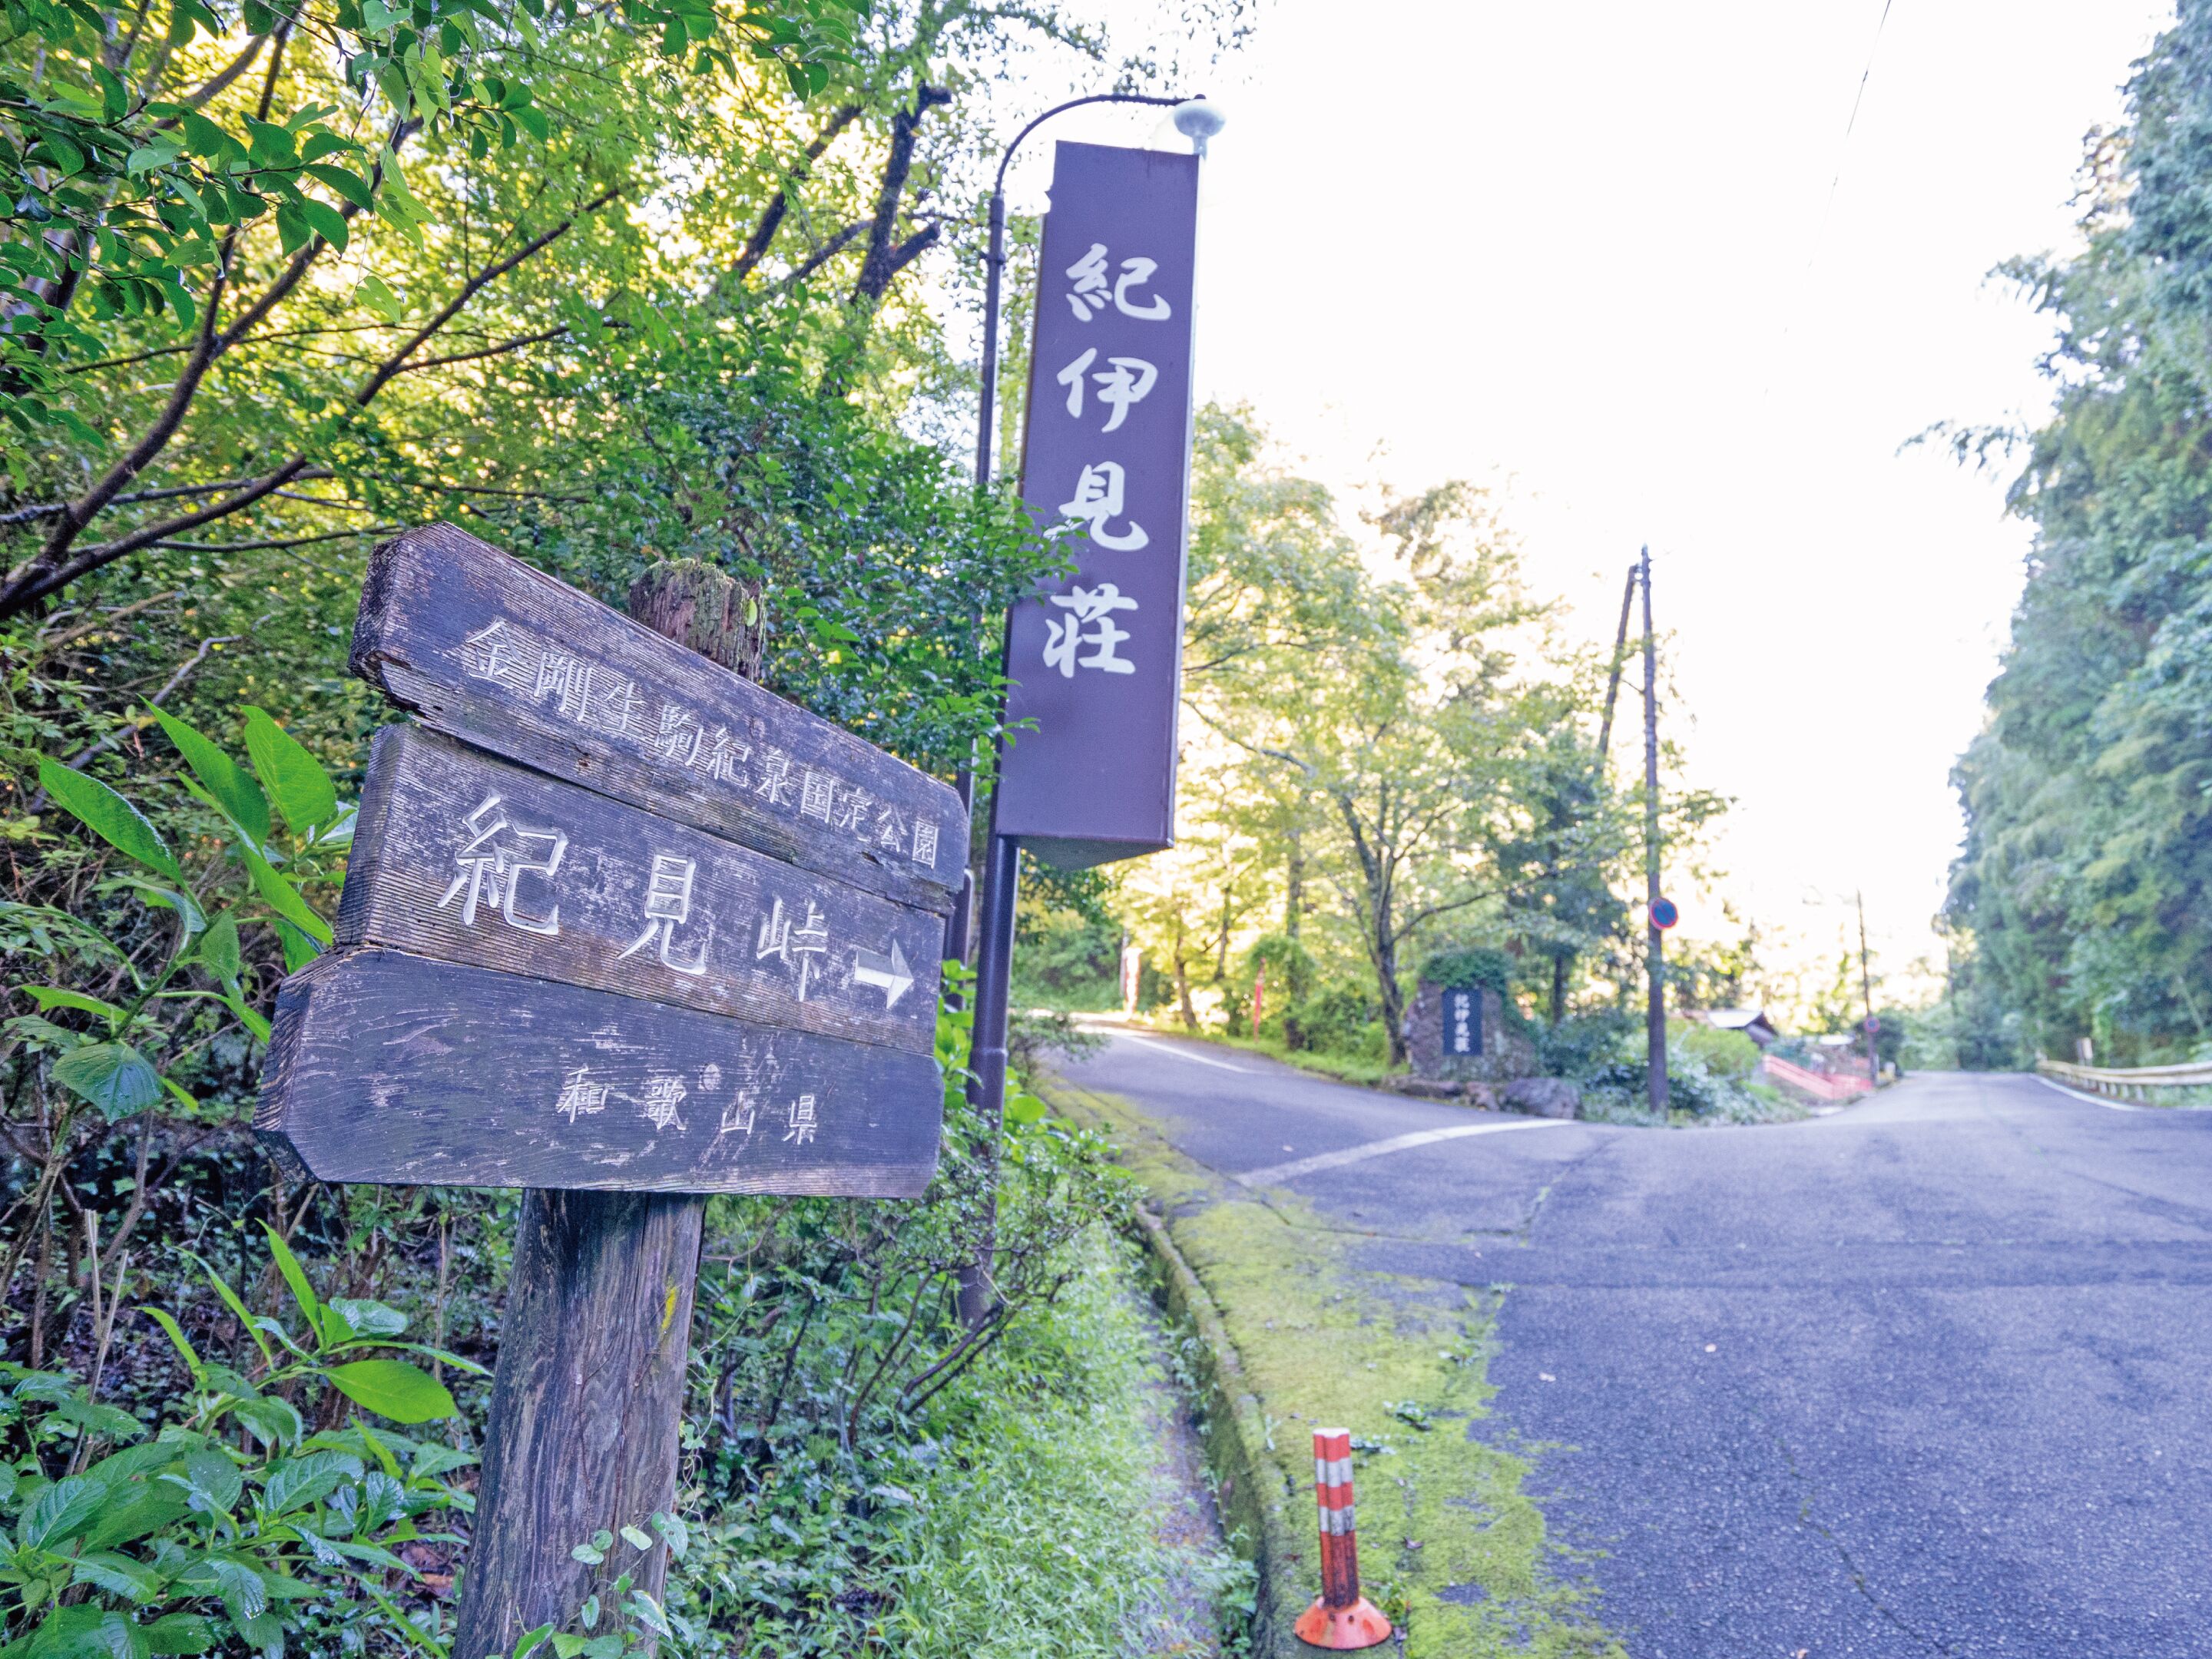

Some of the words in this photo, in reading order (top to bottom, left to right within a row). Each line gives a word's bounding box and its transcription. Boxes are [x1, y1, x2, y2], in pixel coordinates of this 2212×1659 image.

[1042, 243, 1171, 679] 紀伊見荘
[465, 615, 939, 869] 金剛生駒紀泉国定公園
[437, 787, 829, 1002] 紀見峠
[557, 1063, 818, 1146] 和歌山県
